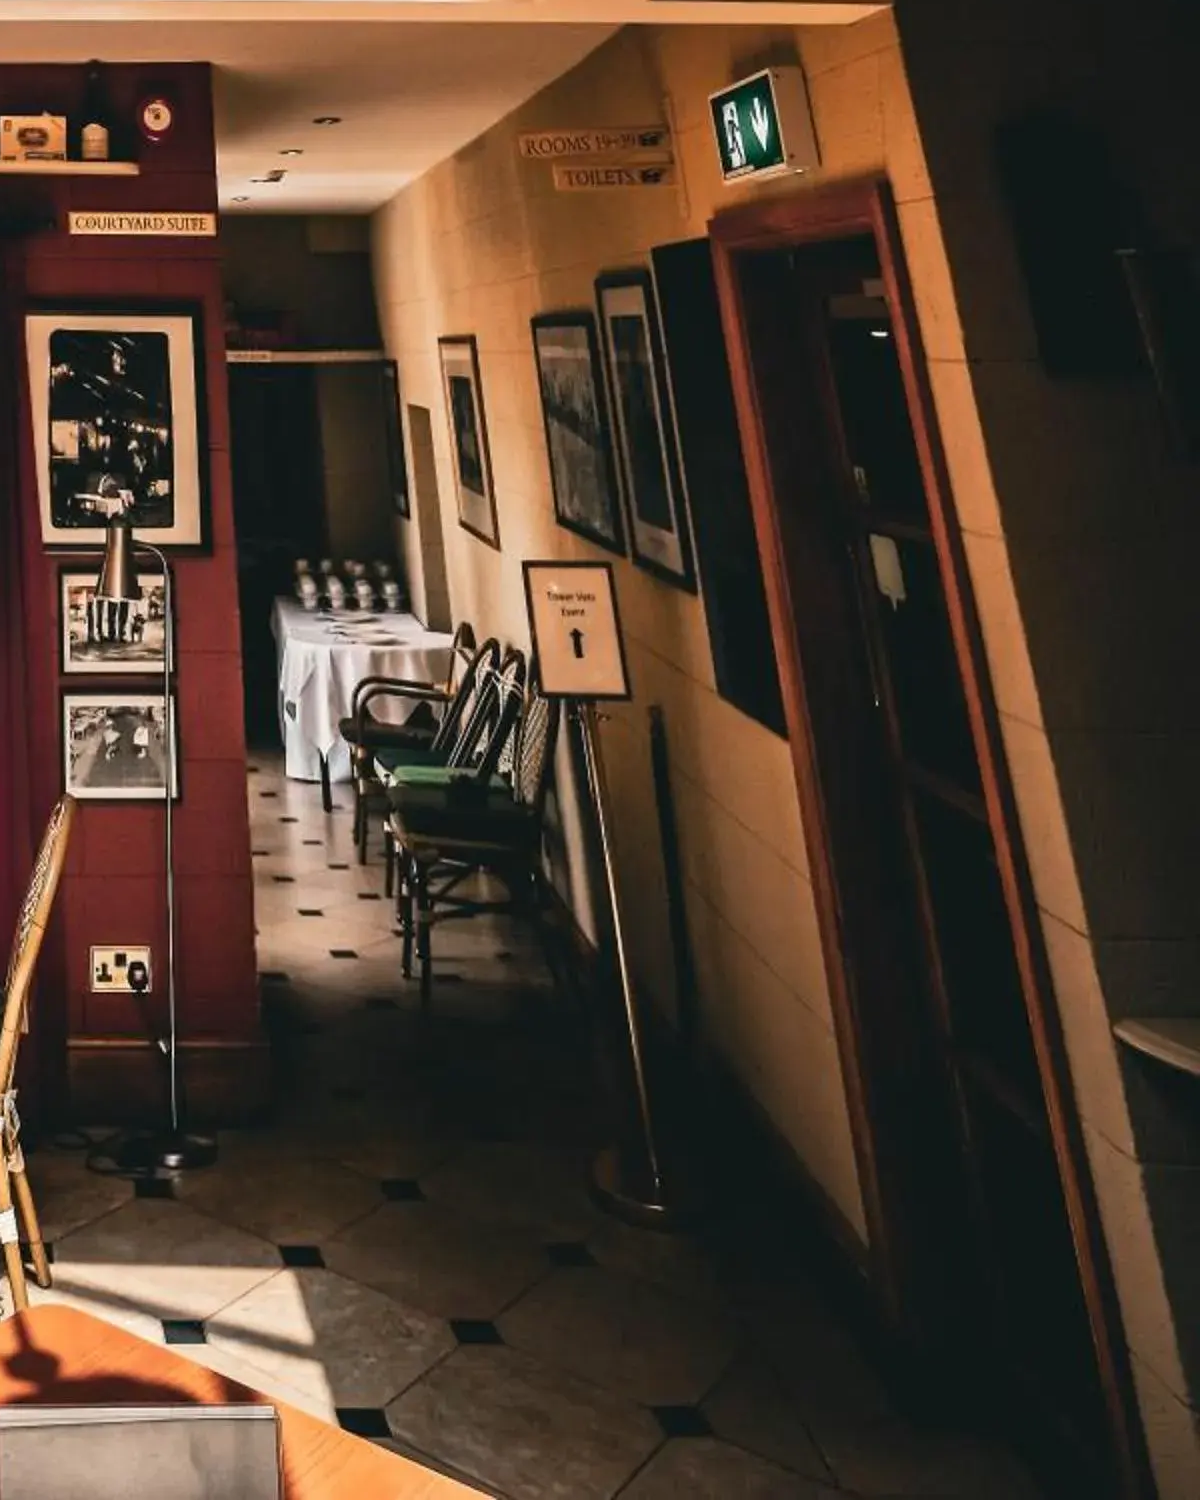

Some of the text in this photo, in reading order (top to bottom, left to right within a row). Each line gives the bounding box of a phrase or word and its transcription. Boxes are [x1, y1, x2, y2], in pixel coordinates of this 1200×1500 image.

[524, 136, 591, 155] ROOMS
[562, 169, 635, 187] TOILETS
[75, 217, 208, 231] COURTYARD SUITE
